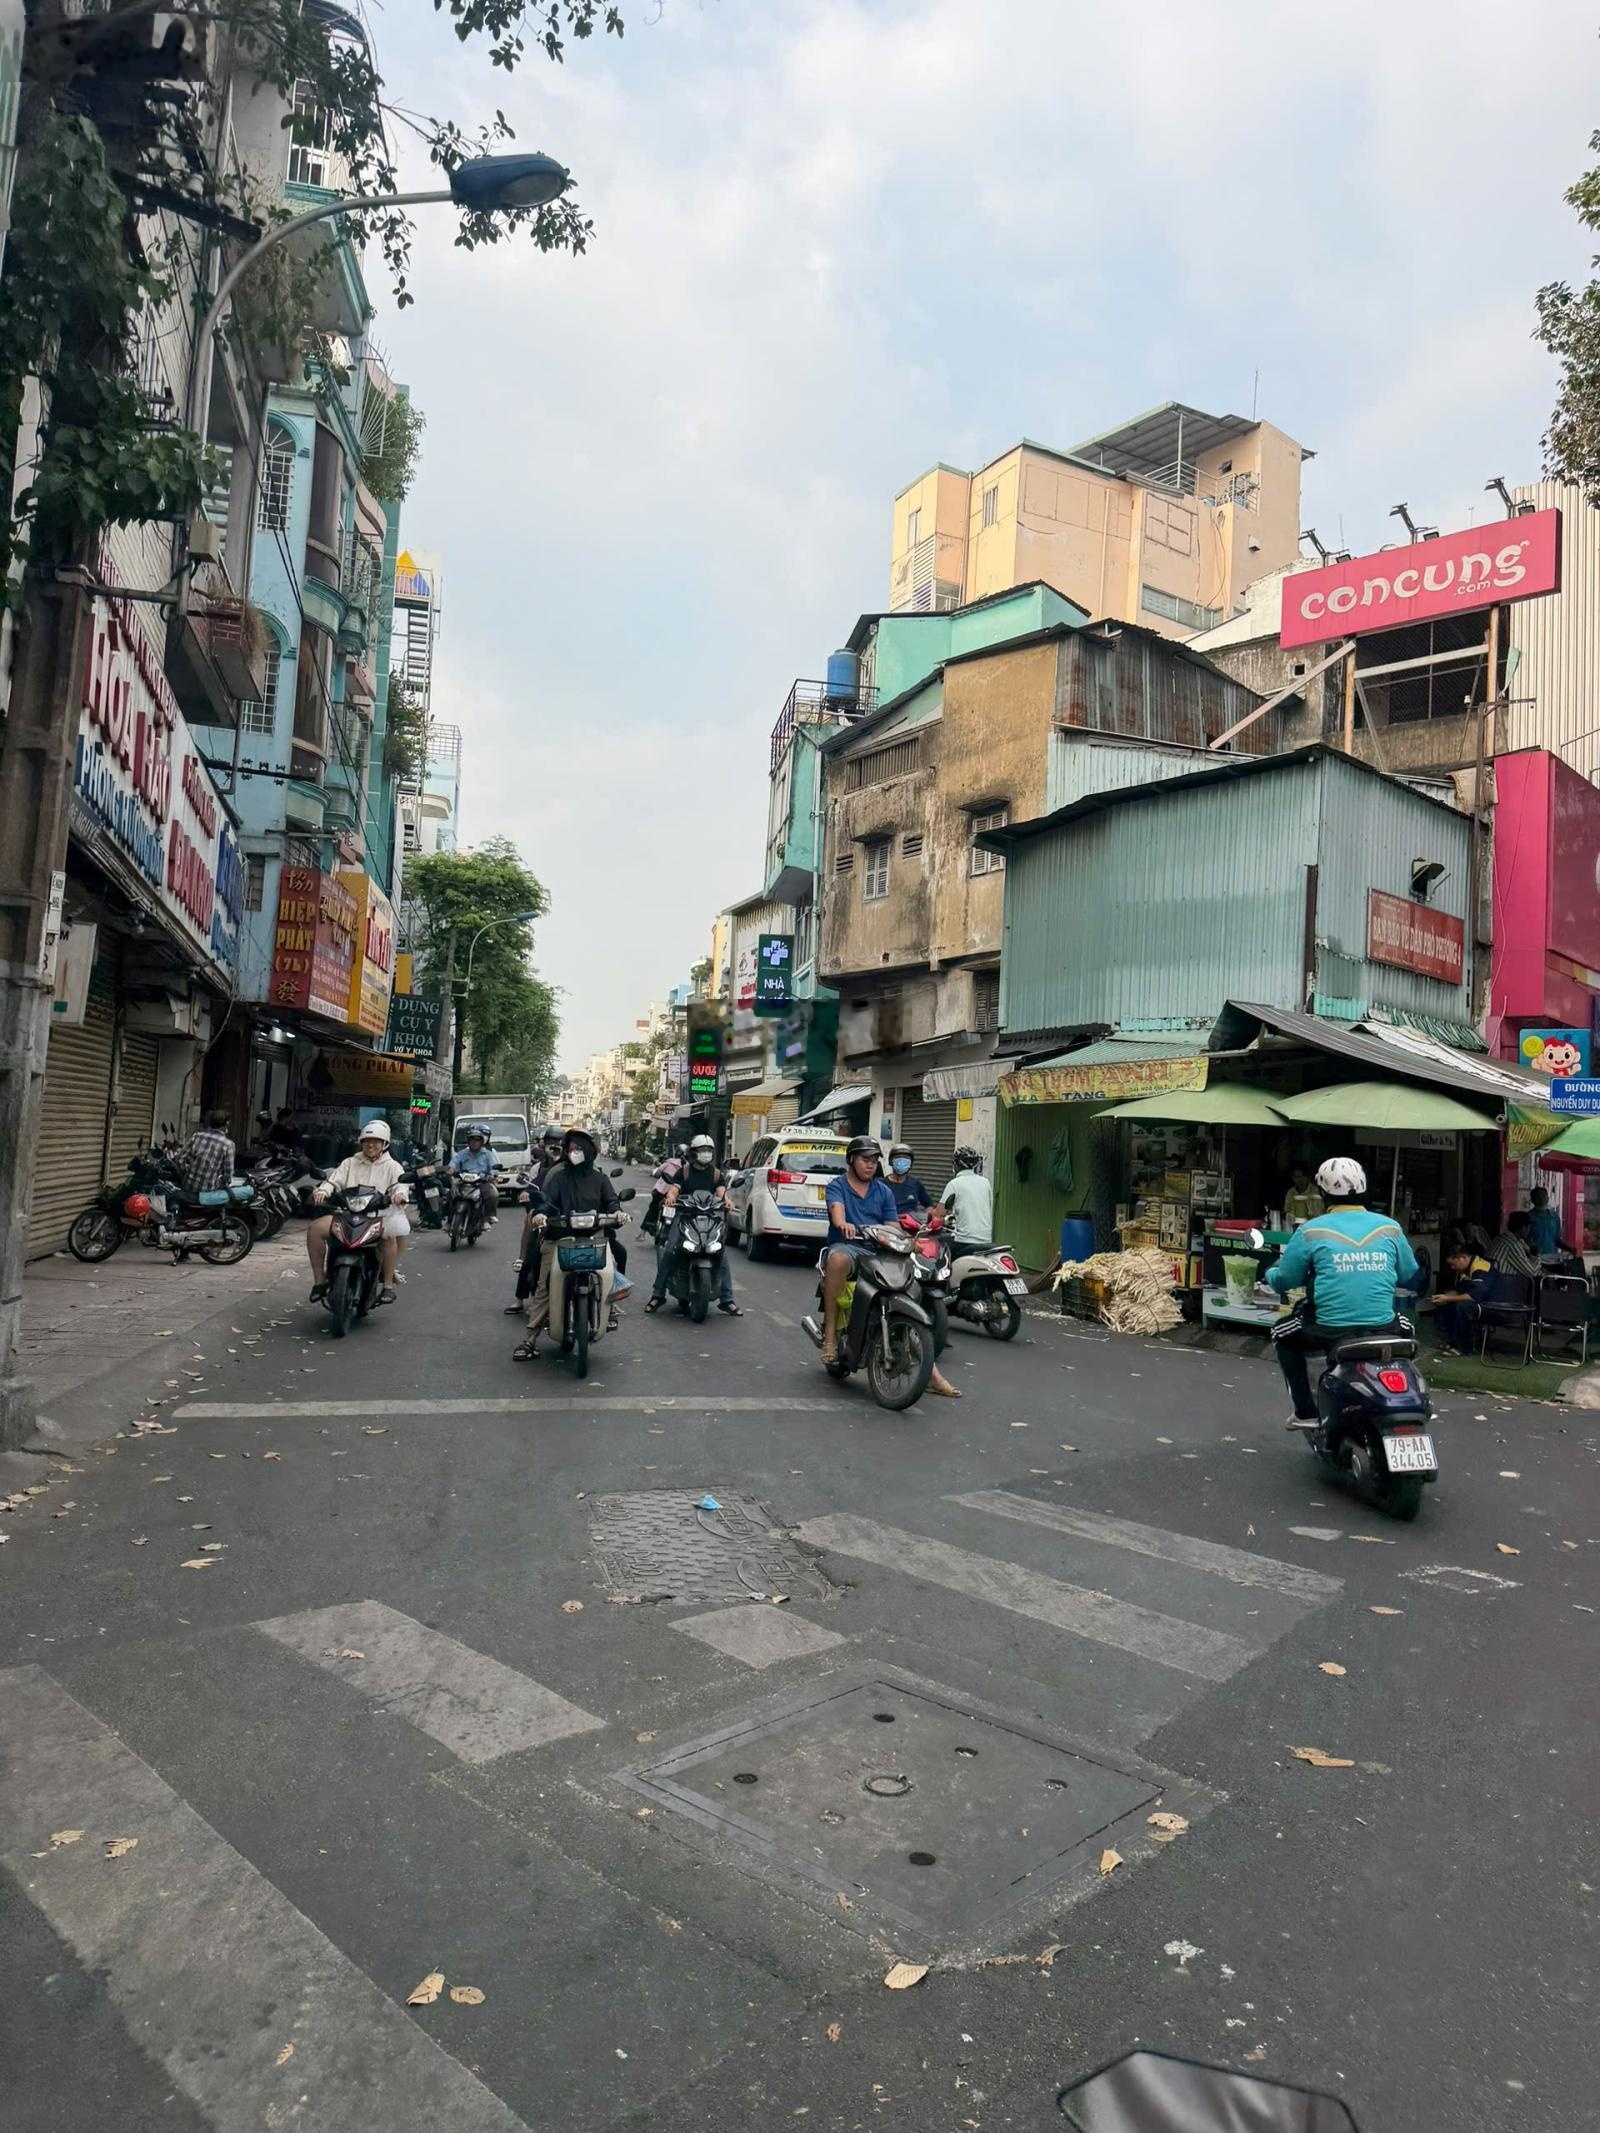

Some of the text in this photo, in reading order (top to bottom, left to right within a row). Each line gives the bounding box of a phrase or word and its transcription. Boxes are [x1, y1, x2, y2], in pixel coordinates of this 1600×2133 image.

[1300, 541, 1527, 620] concung
[84, 614, 172, 824] HÒA HẢO
[75, 734, 118, 828] PHÒNG
[279, 897, 316, 925] HIỆP
[276, 924, 314, 950] PHÁT
[764, 976, 785, 990] NHÀ
[398, 998, 440, 1015] DỤNG
[400, 1015, 421, 1031] CỤ
[425, 1018, 435, 1030] Y
[394, 1032, 435, 1048] KHOA
[412, 1048, 433, 1057] KHOA
[1564, 1081, 1600, 1092] ĐƯỜNG
[1578, 1098, 1591, 1109] DUY
[1332, 1251, 1388, 1263] XANH SM
[1336, 1262, 1354, 1273] xin
[1391, 1438, 1427, 1453] 79-AA
[1391, 1453, 1434, 1469] 344.05
